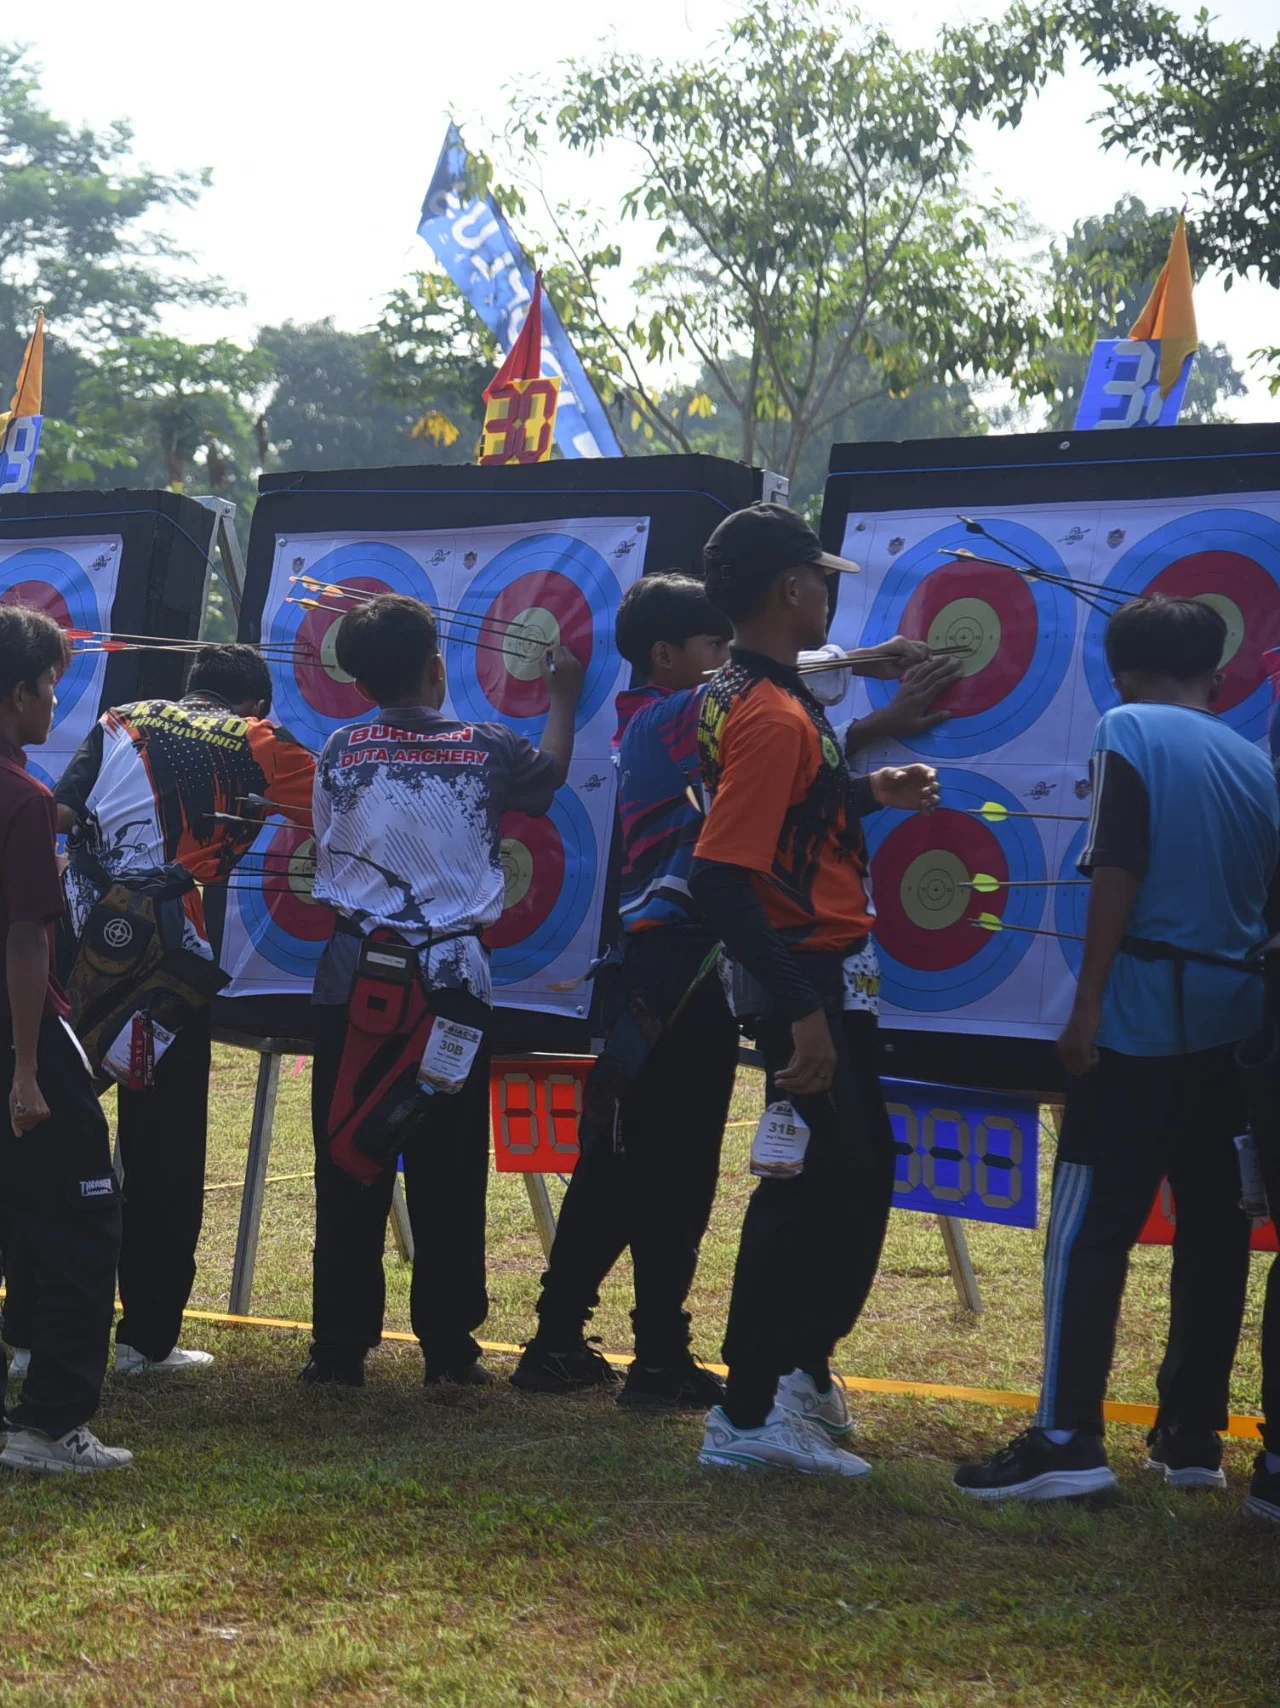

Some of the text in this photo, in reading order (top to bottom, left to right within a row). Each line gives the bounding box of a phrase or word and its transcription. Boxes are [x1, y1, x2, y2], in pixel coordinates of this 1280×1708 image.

[479, 378, 558, 465] 30
[341, 748, 490, 769] DUTA ARCHERY
[439, 1039, 464, 1056] 30B
[768, 1121, 796, 1135] 31B
